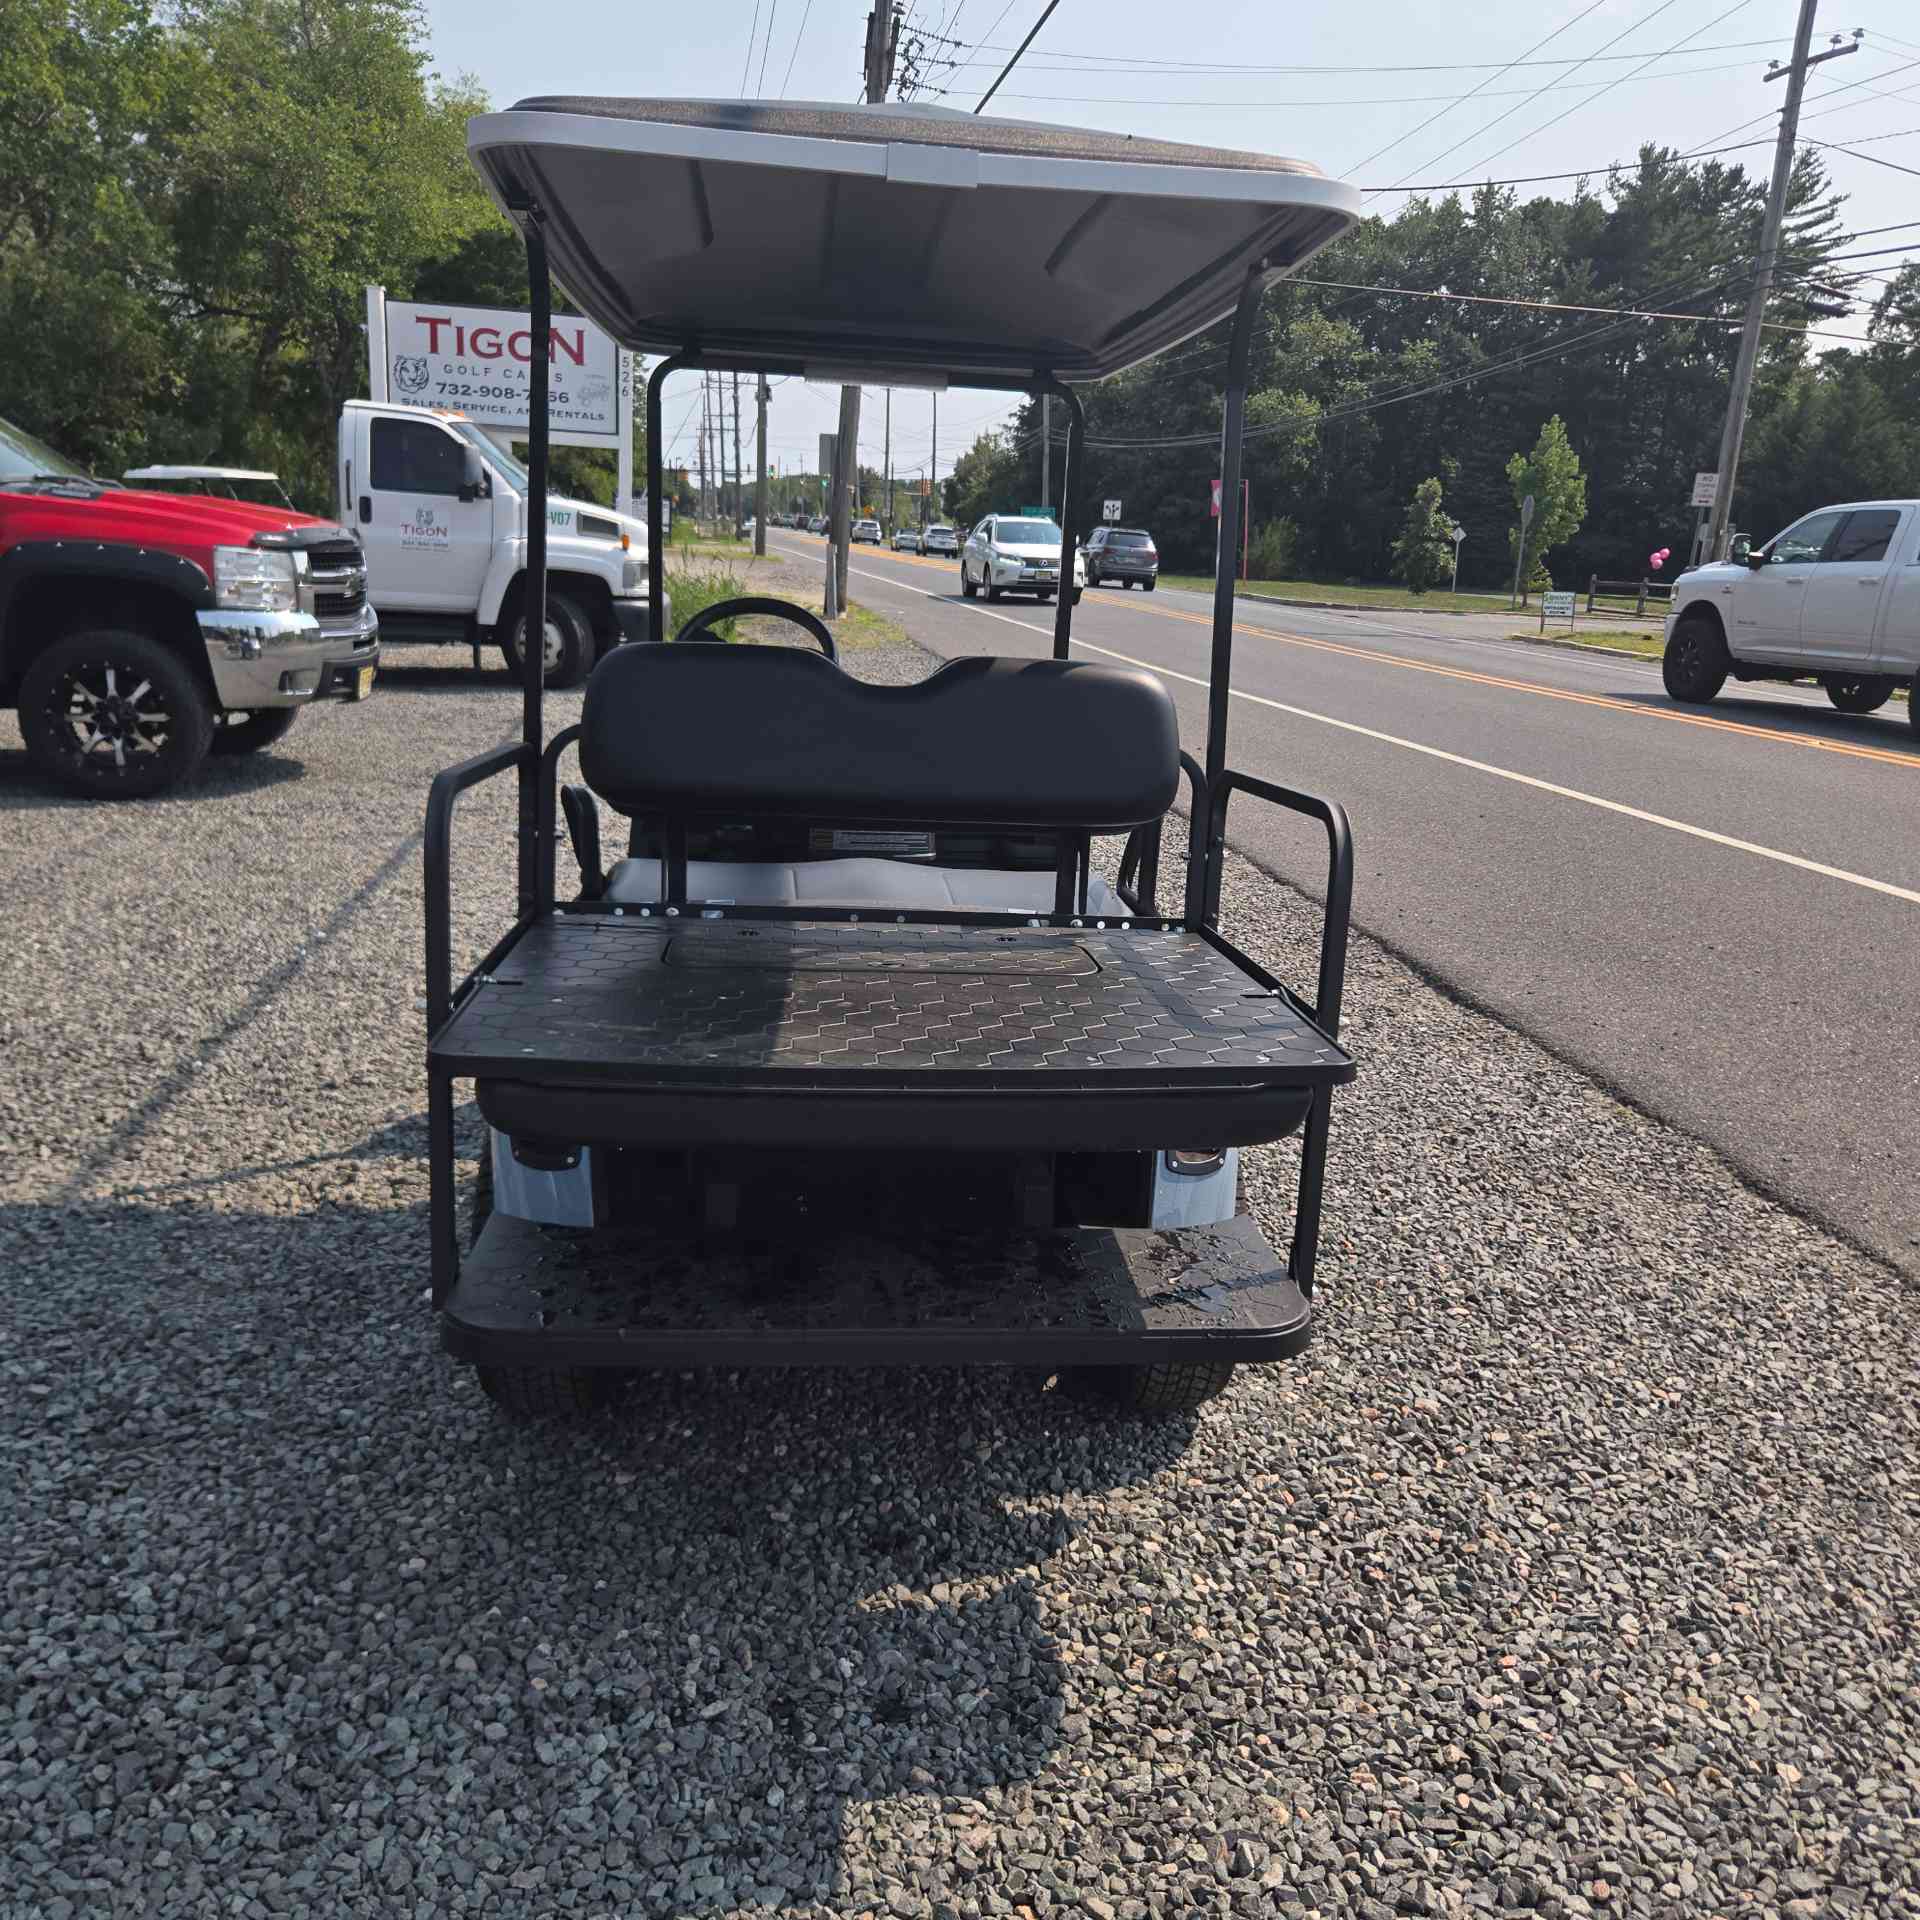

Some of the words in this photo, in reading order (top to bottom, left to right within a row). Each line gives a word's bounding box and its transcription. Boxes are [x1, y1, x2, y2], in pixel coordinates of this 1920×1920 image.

[416, 316, 584, 366] TIGON
[443, 363, 492, 377] GOLF
[503, 368, 562, 384] CAS
[435, 382, 570, 404] 732-908-756
[453, 401, 512, 416] SERVICE,
[548, 408, 605, 421] RENTALS
[400, 523, 449, 537] TIGON
